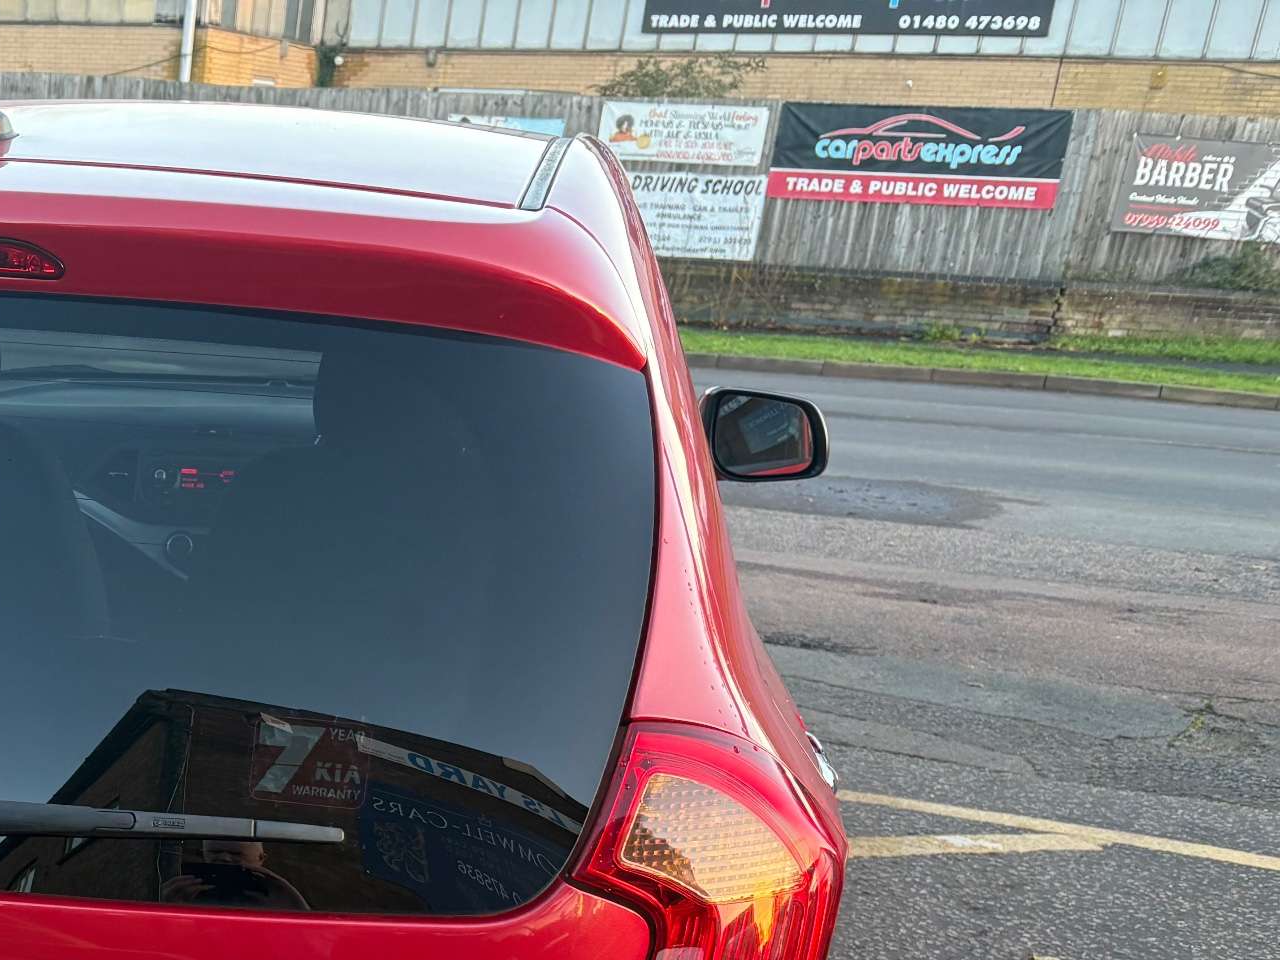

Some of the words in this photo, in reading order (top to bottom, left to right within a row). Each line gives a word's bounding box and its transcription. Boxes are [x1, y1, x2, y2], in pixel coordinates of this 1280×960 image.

[650, 14, 699, 28] TRADE
[704, 15, 717, 28] &
[722, 14, 777, 29] PUBLIC
[783, 14, 862, 29] WELCOME
[899, 15, 959, 30] 01480
[964, 15, 1041, 31] 473698
[815, 136, 1023, 169] carpartsexpress
[632, 174, 699, 194] DRIVING
[701, 178, 763, 196] SCHOOL
[1133, 156, 1235, 193] BARBER
[785, 176, 844, 193] TRADE
[849, 179, 862, 194] &
[868, 179, 936, 197] PUBLIC
[942, 182, 1038, 201] WELCOME
[314, 760, 362, 785] KIA
[291, 784, 362, 801] WARRANTY
